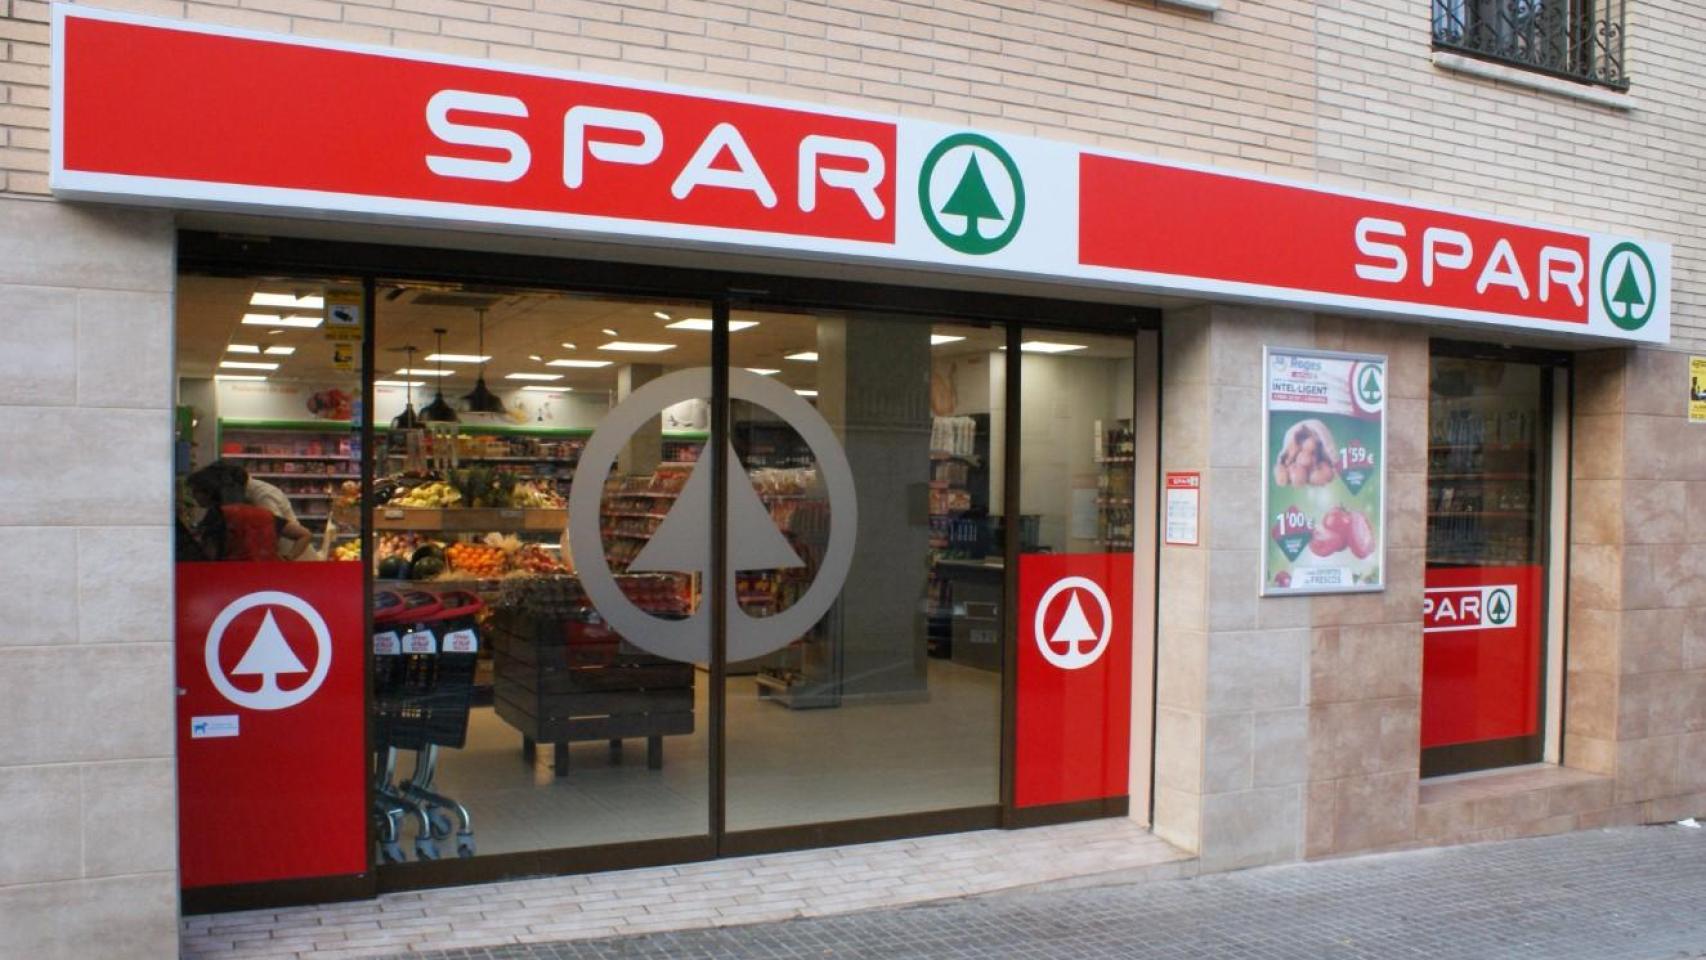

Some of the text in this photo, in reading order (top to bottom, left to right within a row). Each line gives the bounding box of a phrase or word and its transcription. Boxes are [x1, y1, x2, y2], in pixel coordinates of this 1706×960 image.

[425, 89, 885, 220] SPAR
[1355, 217, 1584, 307] SPAR
[1424, 596, 1480, 622] PAR
